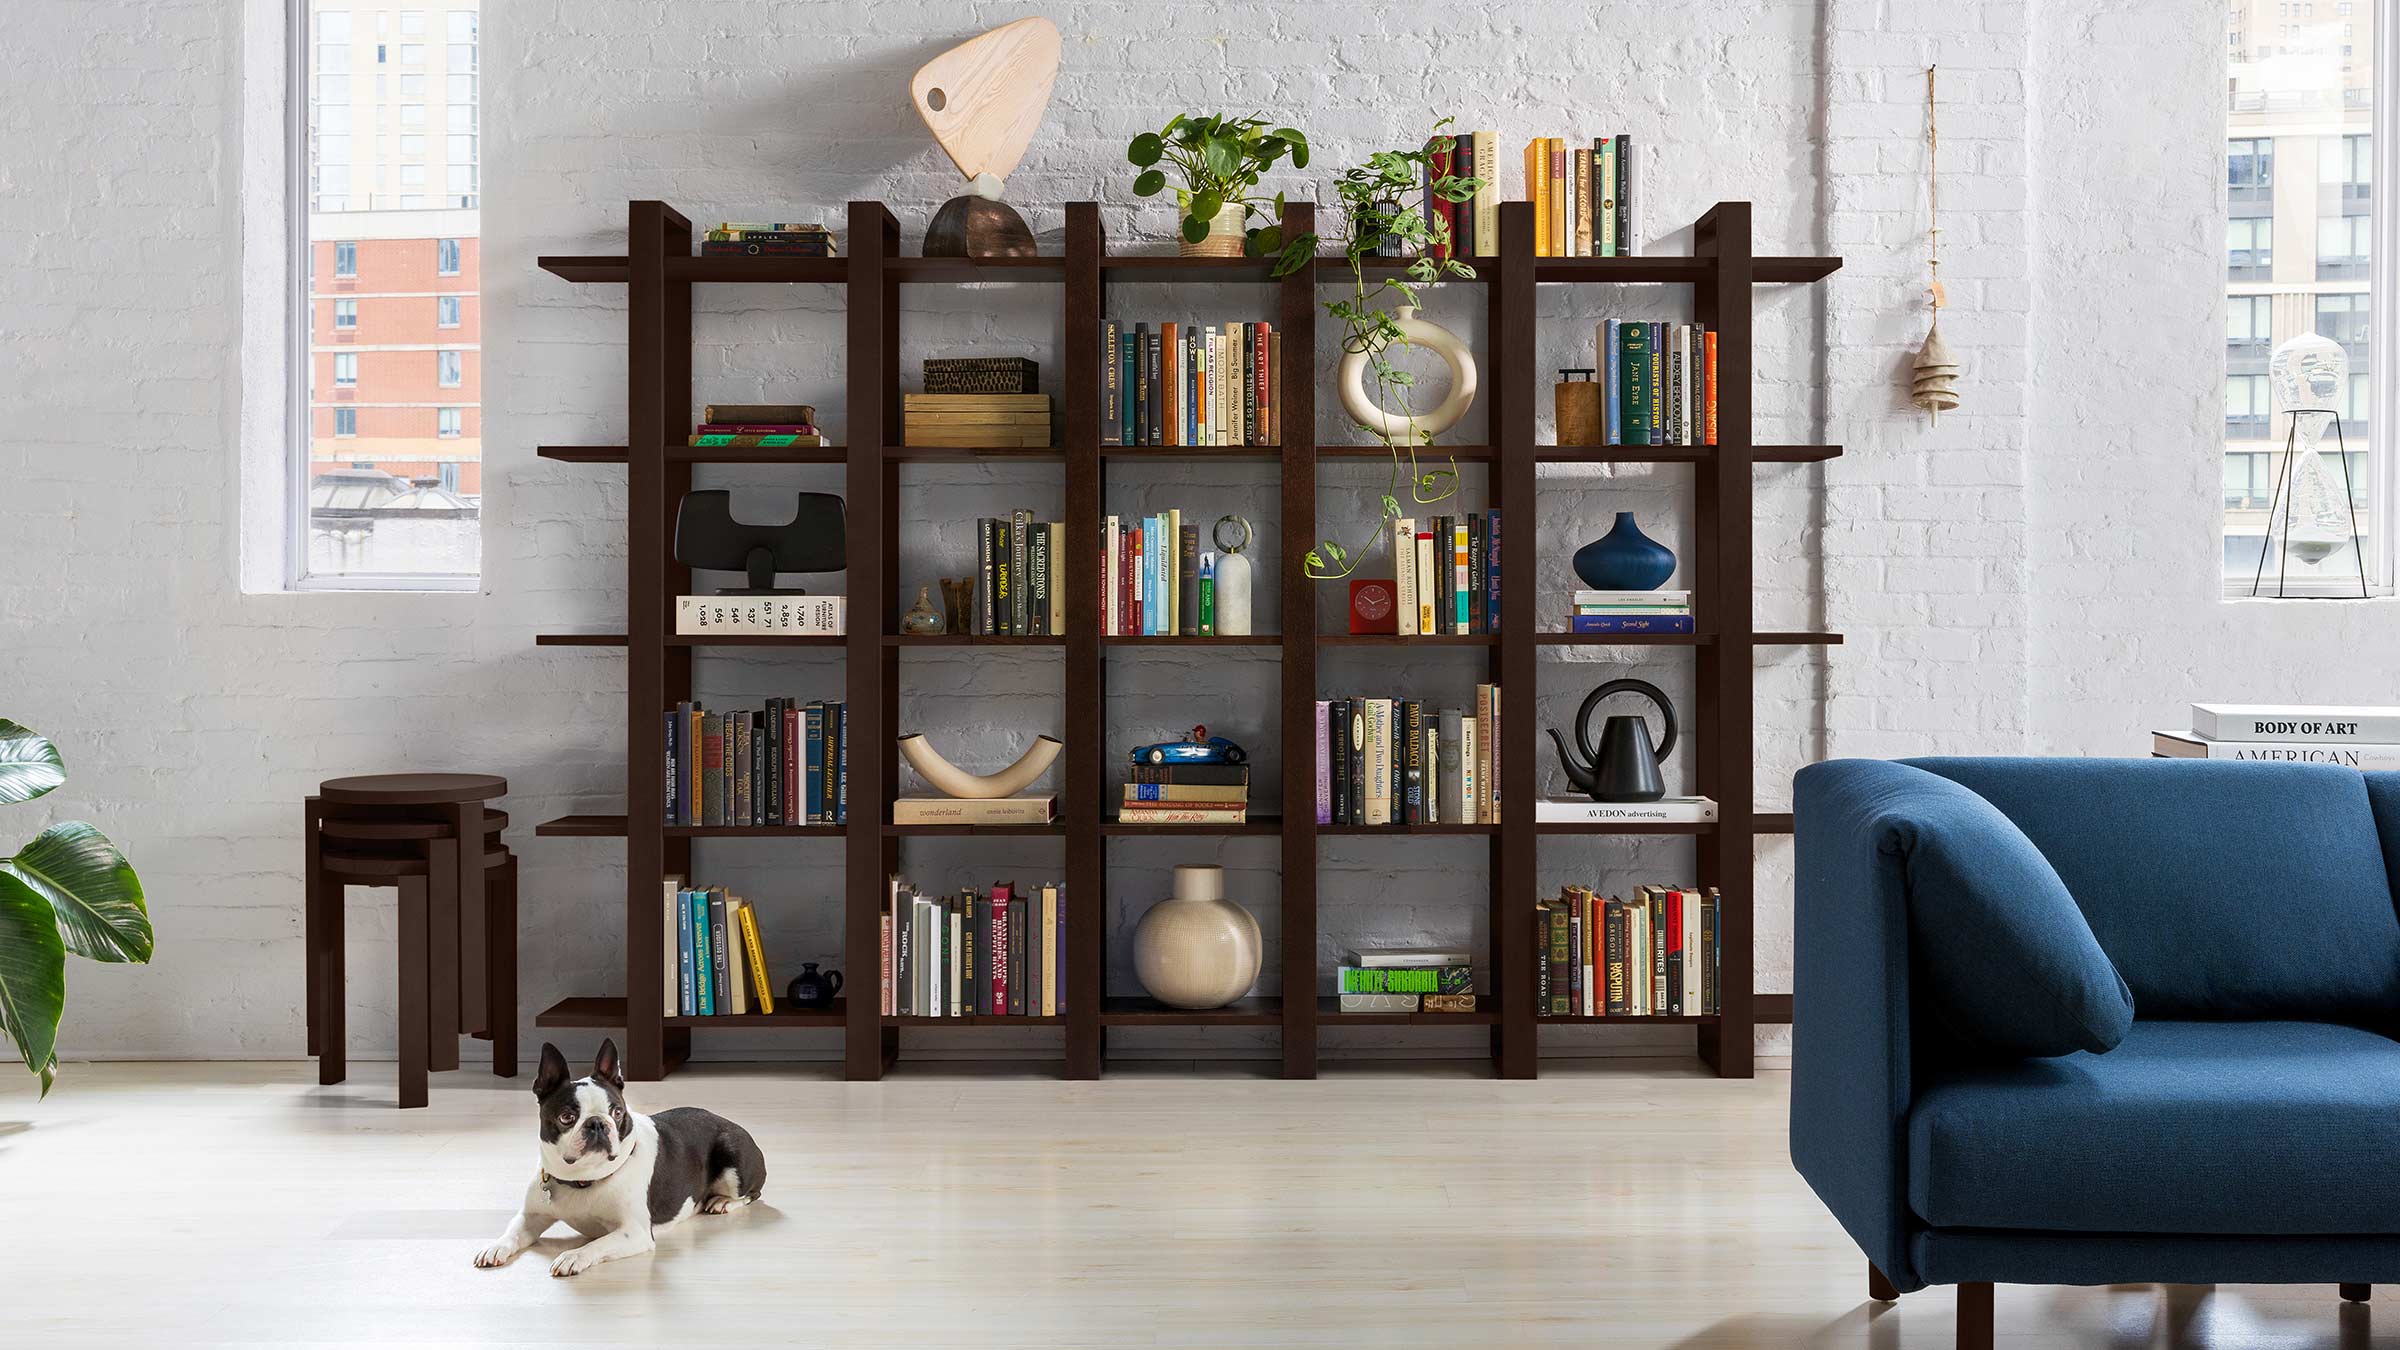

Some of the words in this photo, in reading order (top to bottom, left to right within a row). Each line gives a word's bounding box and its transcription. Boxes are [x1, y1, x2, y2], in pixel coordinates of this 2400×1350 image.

[1479, 148, 1487, 179] GRACE
[1579, 152, 1589, 177] SEARCH
[1579, 190, 1589, 217] ACCORD
[1107, 323, 1116, 364] SKELETON
[1257, 333, 1265, 347] THE
[1208, 355, 1214, 364] AS
[1230, 339, 1239, 367] Summer
[1257, 351, 1265, 366] ART
[1107, 367, 1116, 390] CREW
[1230, 369, 1239, 380] Big
[1631, 362, 1641, 383] JANE
[1652, 352, 1660, 387] TOURISTS
[1673, 353, 1682, 382] ALEXEY
[1257, 369, 1265, 392] THIEF
[1652, 388, 1660, 396] OF
[1231, 386, 1239, 412] Weiner
[1631, 385, 1641, 406] EYRE
[1246, 409, 1253, 419] SO
[1652, 397, 1660, 430] HISTORY
[1706, 400, 1717, 440] FUSANG
[1231, 413, 1239, 441] Jennifer
[1013, 512, 1024, 541] Cilka's
[1036, 532, 1046, 546] THE
[1470, 537, 1479, 548] The
[1013, 542, 1024, 578] Journey
[1036, 546, 1046, 573] SACRED
[1159, 545, 1168, 583] Liquidated
[1036, 574, 1046, 600] STONES
[699, 604, 708, 627] 1,028
[714, 607, 723, 625] 565
[731, 607, 740, 625] 546
[747, 608, 756, 625] 237
[764, 602, 772, 615] 551
[781, 604, 790, 628] 2,852
[764, 618, 772, 629] 71
[828, 620, 833, 629] OF
[1367, 702, 1376, 716] Gail
[1409, 703, 1419, 728] DAVID
[1367, 717, 1376, 743] Godwin
[1375, 709, 1385, 735] Mother
[1393, 708, 1401, 740] Elizabeth
[1479, 693, 1489, 753] POSTSECRET
[2254, 721, 2298, 734] BODY
[2301, 721, 2322, 735] OF
[2324, 722, 2358, 736] ART
[827, 735, 835, 768] IMPERIAL
[1336, 728, 1345, 761] HOBBIT
[1375, 735, 1385, 748] and
[1393, 740, 1401, 761] Strout
[1409, 730, 1419, 767] BALDACCI
[1375, 749, 1385, 764] Two
[2235, 750, 2360, 766] AMERICAN
[827, 769, 835, 800] LEATHER
[1375, 763, 1385, 799] Daughters
[920, 807, 961, 816] wonderland
[1586, 809, 1626, 818] AVEDON
[1627, 810, 1667, 820] advertising
[696, 922, 704, 947] Forever
[697, 949, 705, 972] Across
[698, 973, 706, 995] Bridge
[1387, 970, 1439, 993] SUBURBIA
[1610, 962, 1623, 1002] RASPUTIN
